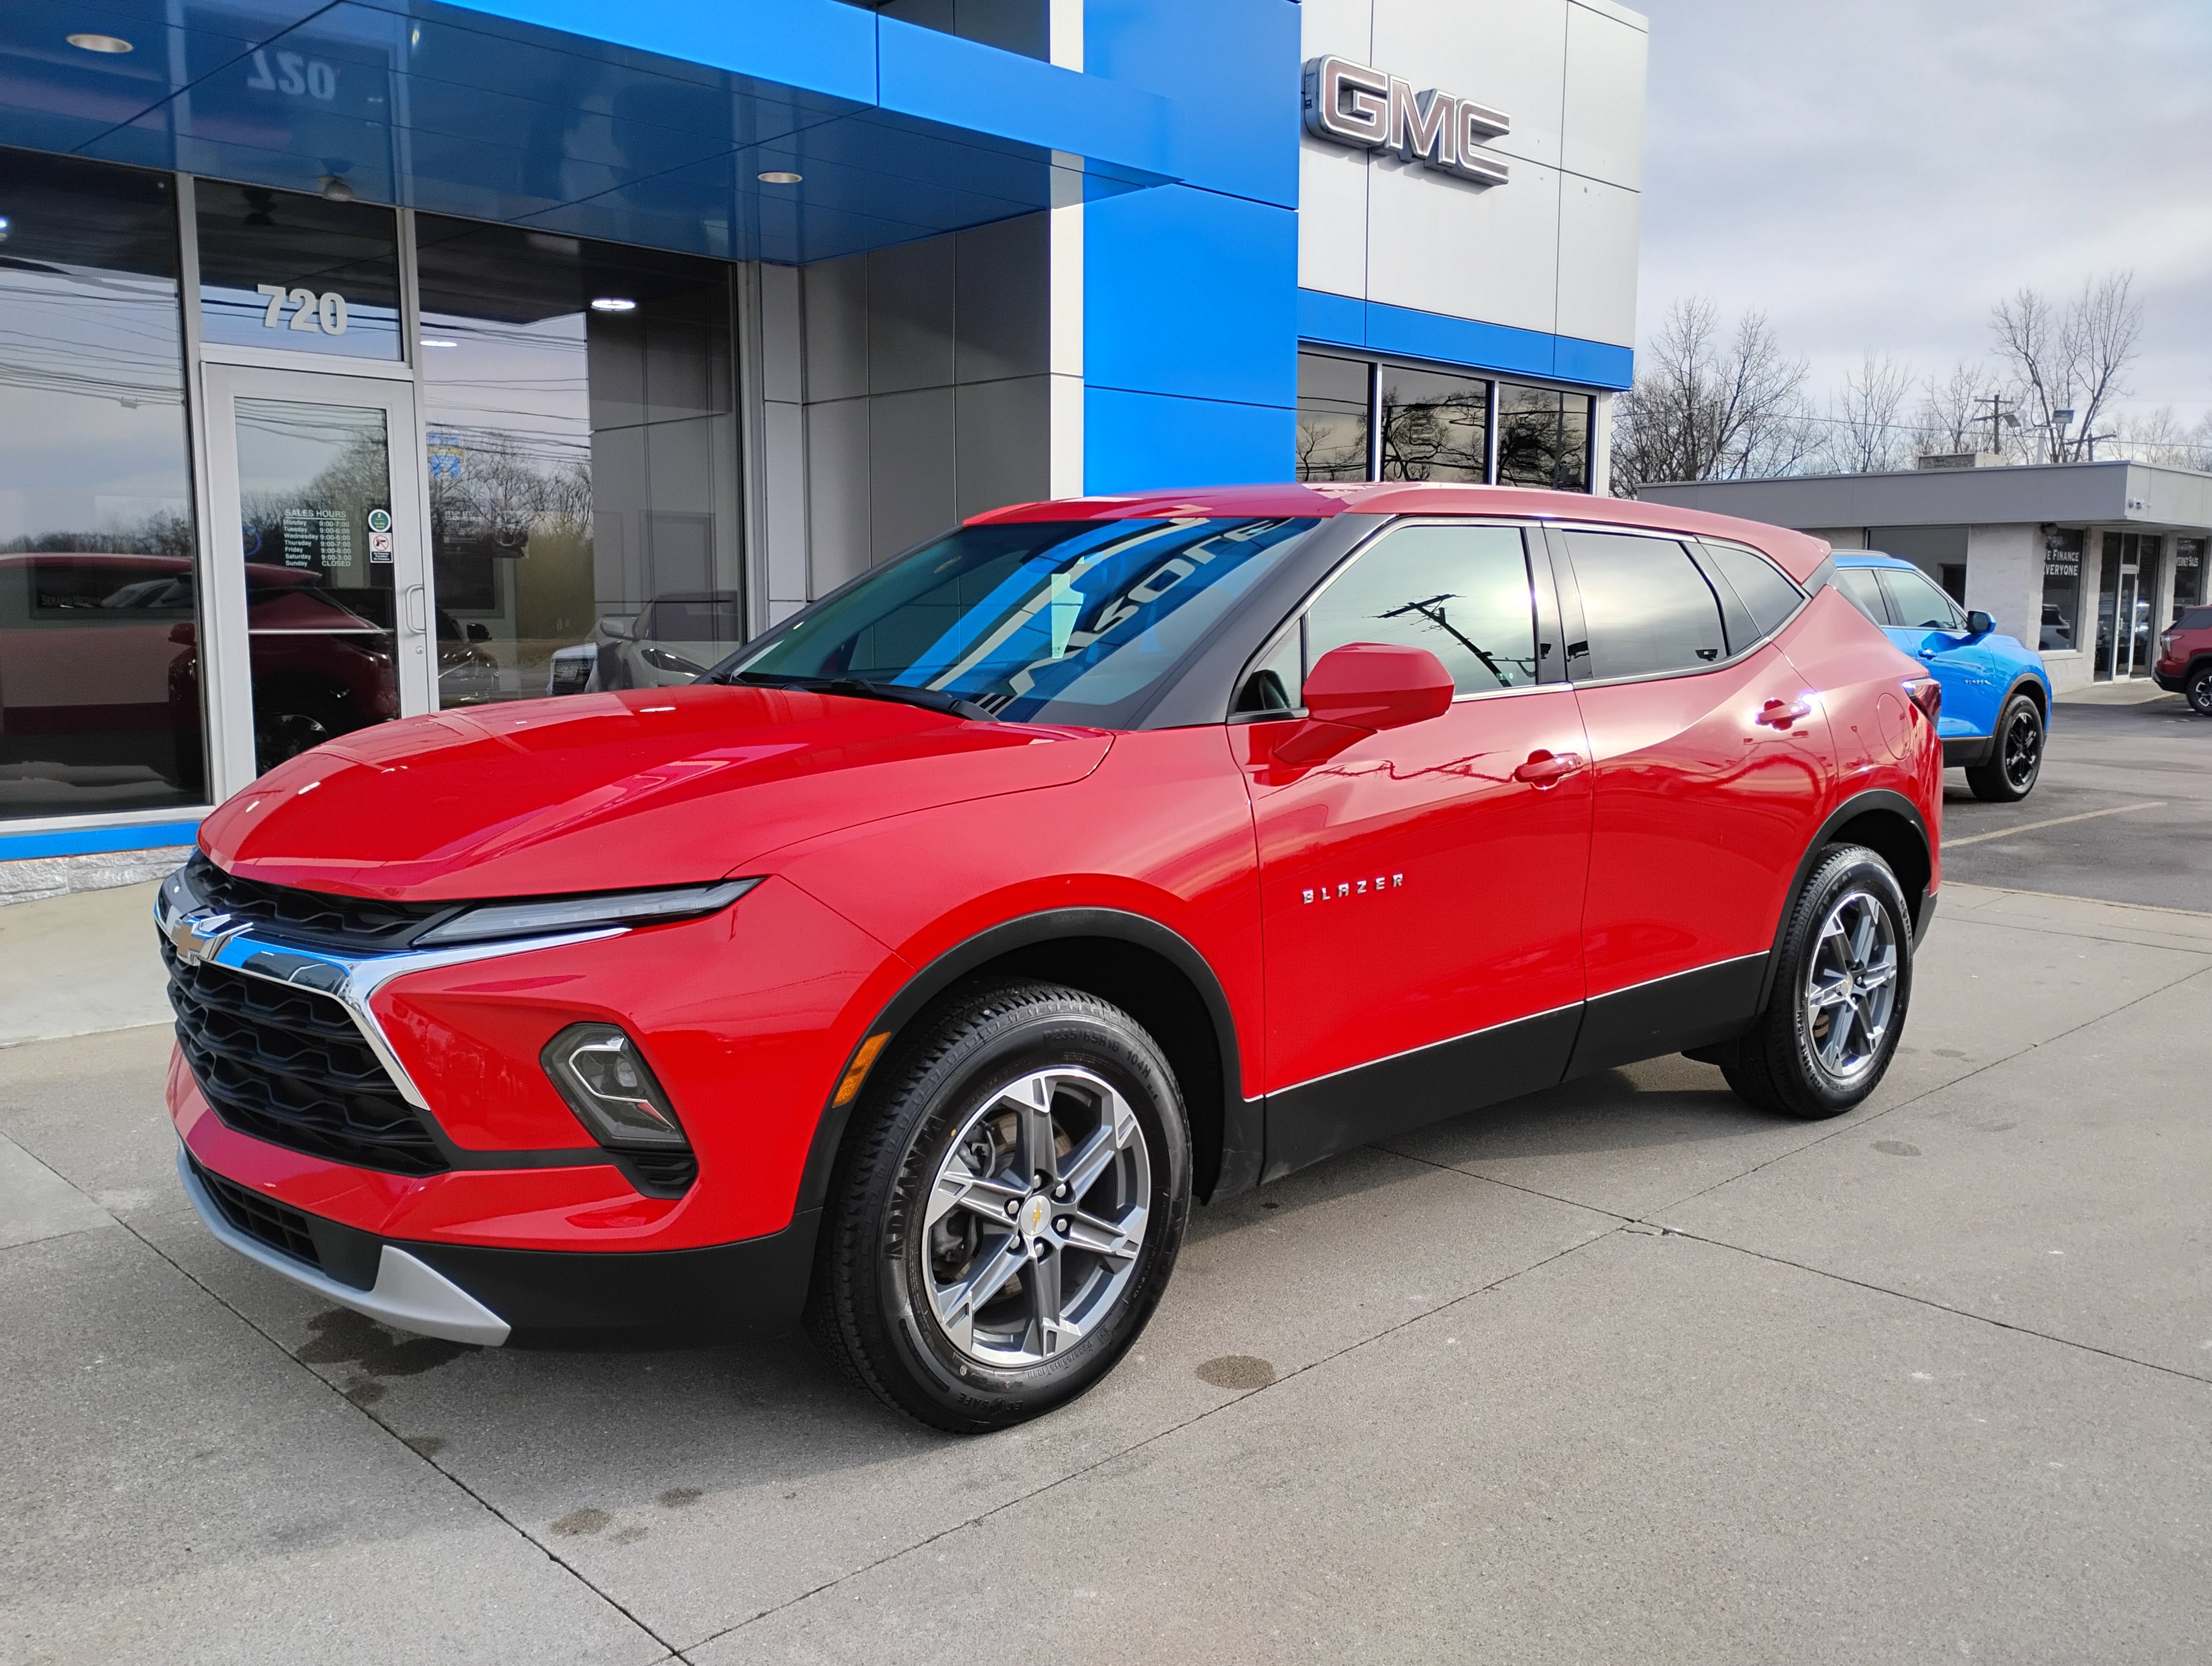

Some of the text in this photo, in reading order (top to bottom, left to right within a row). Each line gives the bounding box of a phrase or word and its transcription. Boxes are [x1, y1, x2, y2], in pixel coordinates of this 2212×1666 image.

[1315, 54, 1511, 184] GMC
[258, 284, 348, 335] 720
[316, 510, 346, 518] HOURS
[284, 533, 318, 541] Wednesday
[2044, 548, 2079, 561] E FINANCE
[2044, 563, 2078, 576] VERYONE
[1302, 873, 1403, 905] BLAZER
[1127, 1049, 1152, 1078] 104H
